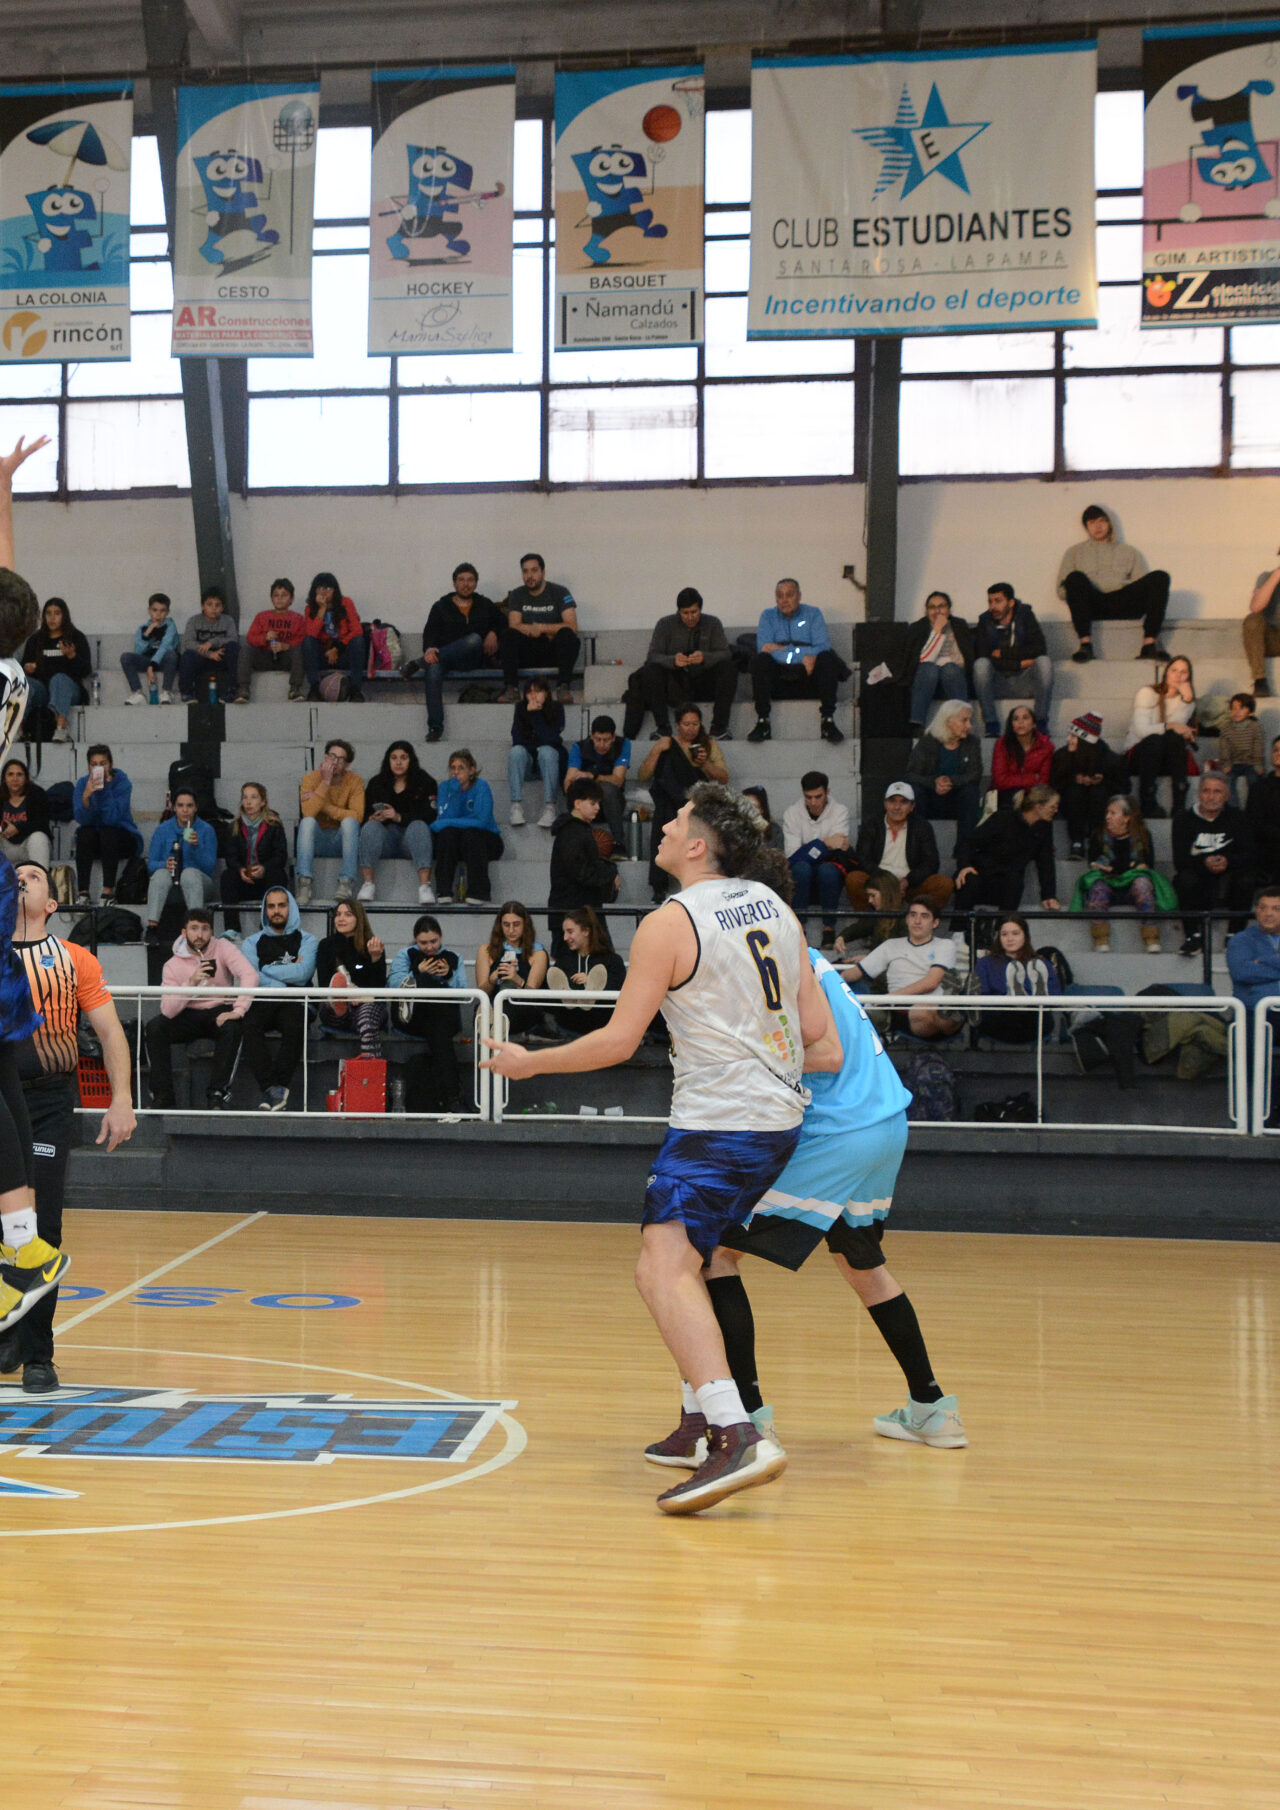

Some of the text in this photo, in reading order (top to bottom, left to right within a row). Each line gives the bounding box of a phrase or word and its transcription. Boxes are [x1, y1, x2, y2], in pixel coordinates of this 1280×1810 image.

[920, 131, 940, 160] E
[772, 207, 1072, 248] CLUB ESTUDIANTES
[217, 285, 270, 298] CESTO
[407, 281, 474, 296] HOCKEY
[589, 274, 667, 289] BASQUET
[16, 291, 107, 306] LA COLONIA
[585, 297, 674, 318] Ñamandú
[765, 285, 1082, 316] Incentivando el deporte
[176, 306, 311, 327] AR Construcciones
[630, 318, 678, 330] Calzados
[53, 323, 123, 343] rincón
[714, 899, 781, 931] RIVEROS
[745, 927, 784, 1014] 6
